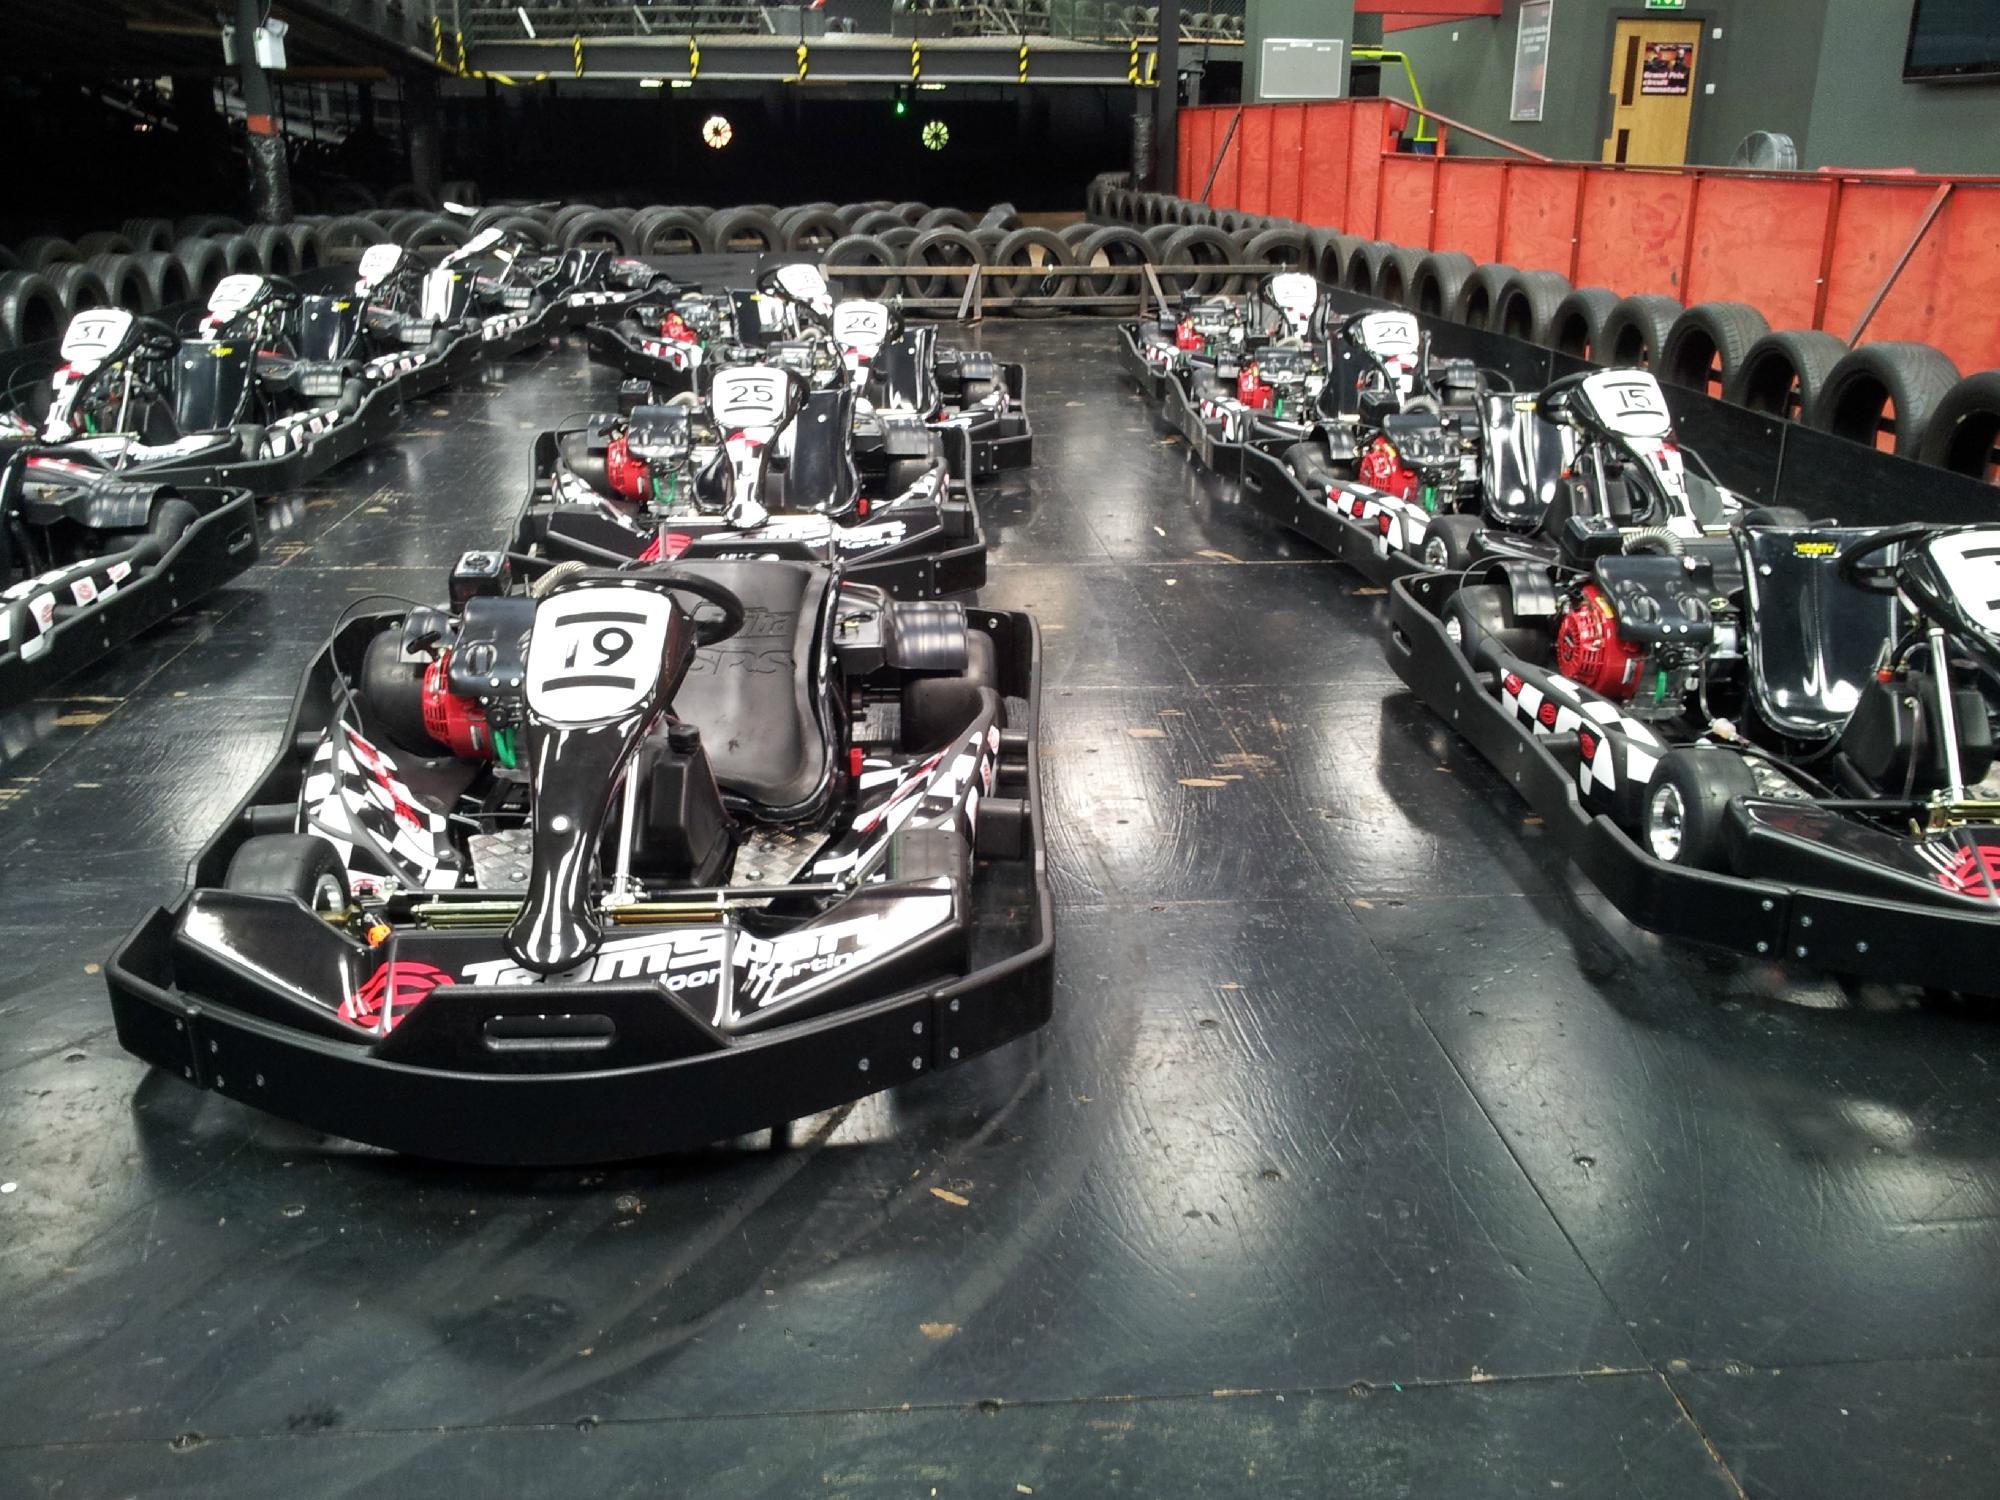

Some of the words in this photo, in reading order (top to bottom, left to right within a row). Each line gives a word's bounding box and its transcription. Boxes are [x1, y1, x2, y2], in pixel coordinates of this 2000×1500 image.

[845, 316, 877, 329] 26
[76, 325, 105, 340] 31
[729, 385, 774, 404] 25
[1619, 389, 1652, 408] 15
[564, 626, 634, 669] 19
